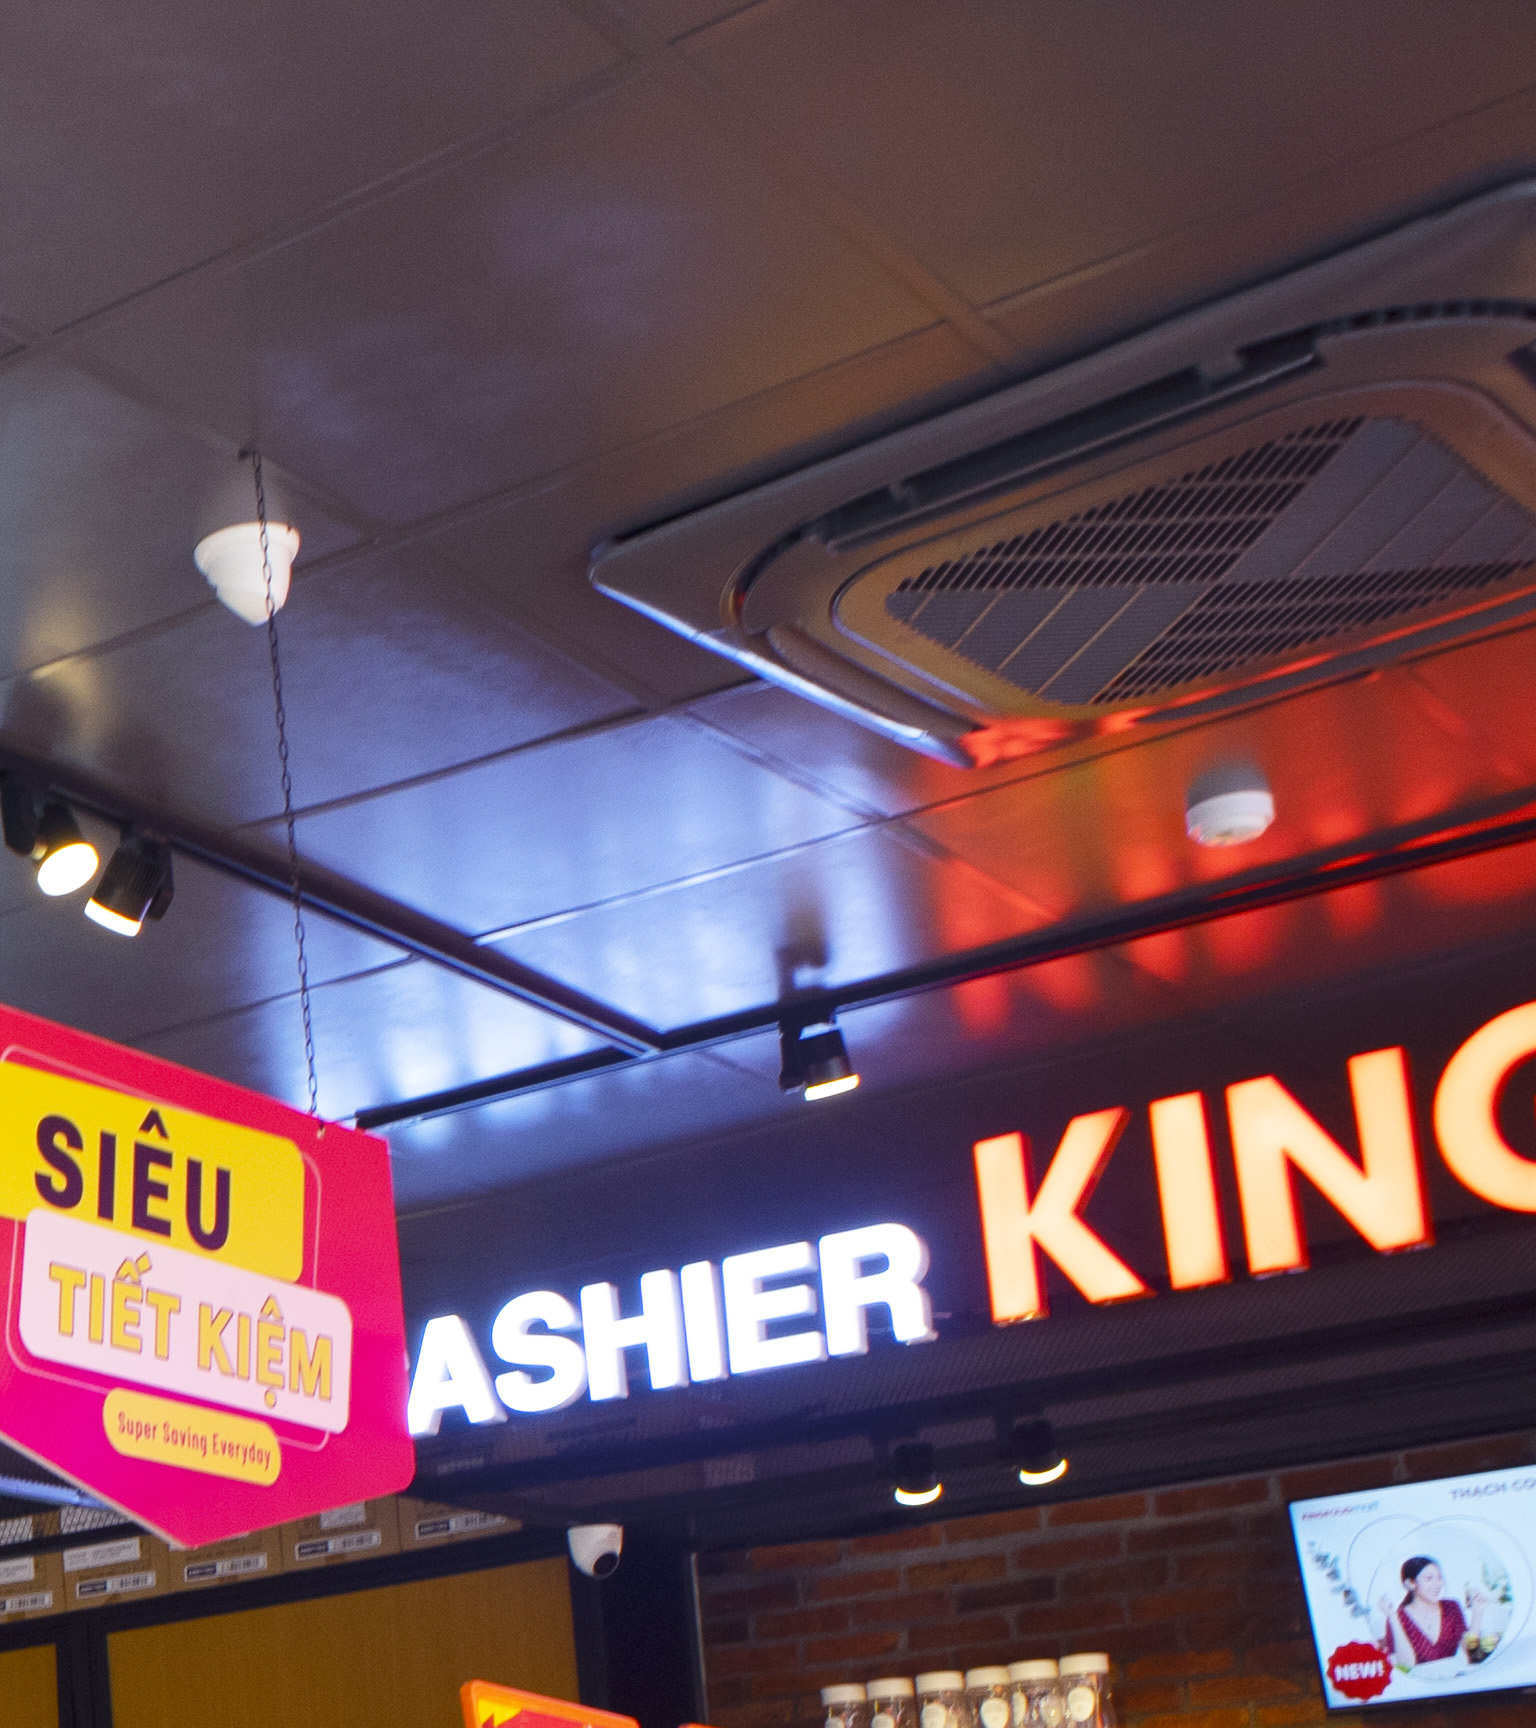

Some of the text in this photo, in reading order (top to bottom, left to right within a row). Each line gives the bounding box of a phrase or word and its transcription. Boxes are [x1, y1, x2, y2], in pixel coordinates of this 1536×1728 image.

[33, 1109, 232, 1251] SIÊU
[49, 1252, 332, 1409] TIẾT KIỆM
[117, 1410, 272, 1471] Super Saving Everyday
